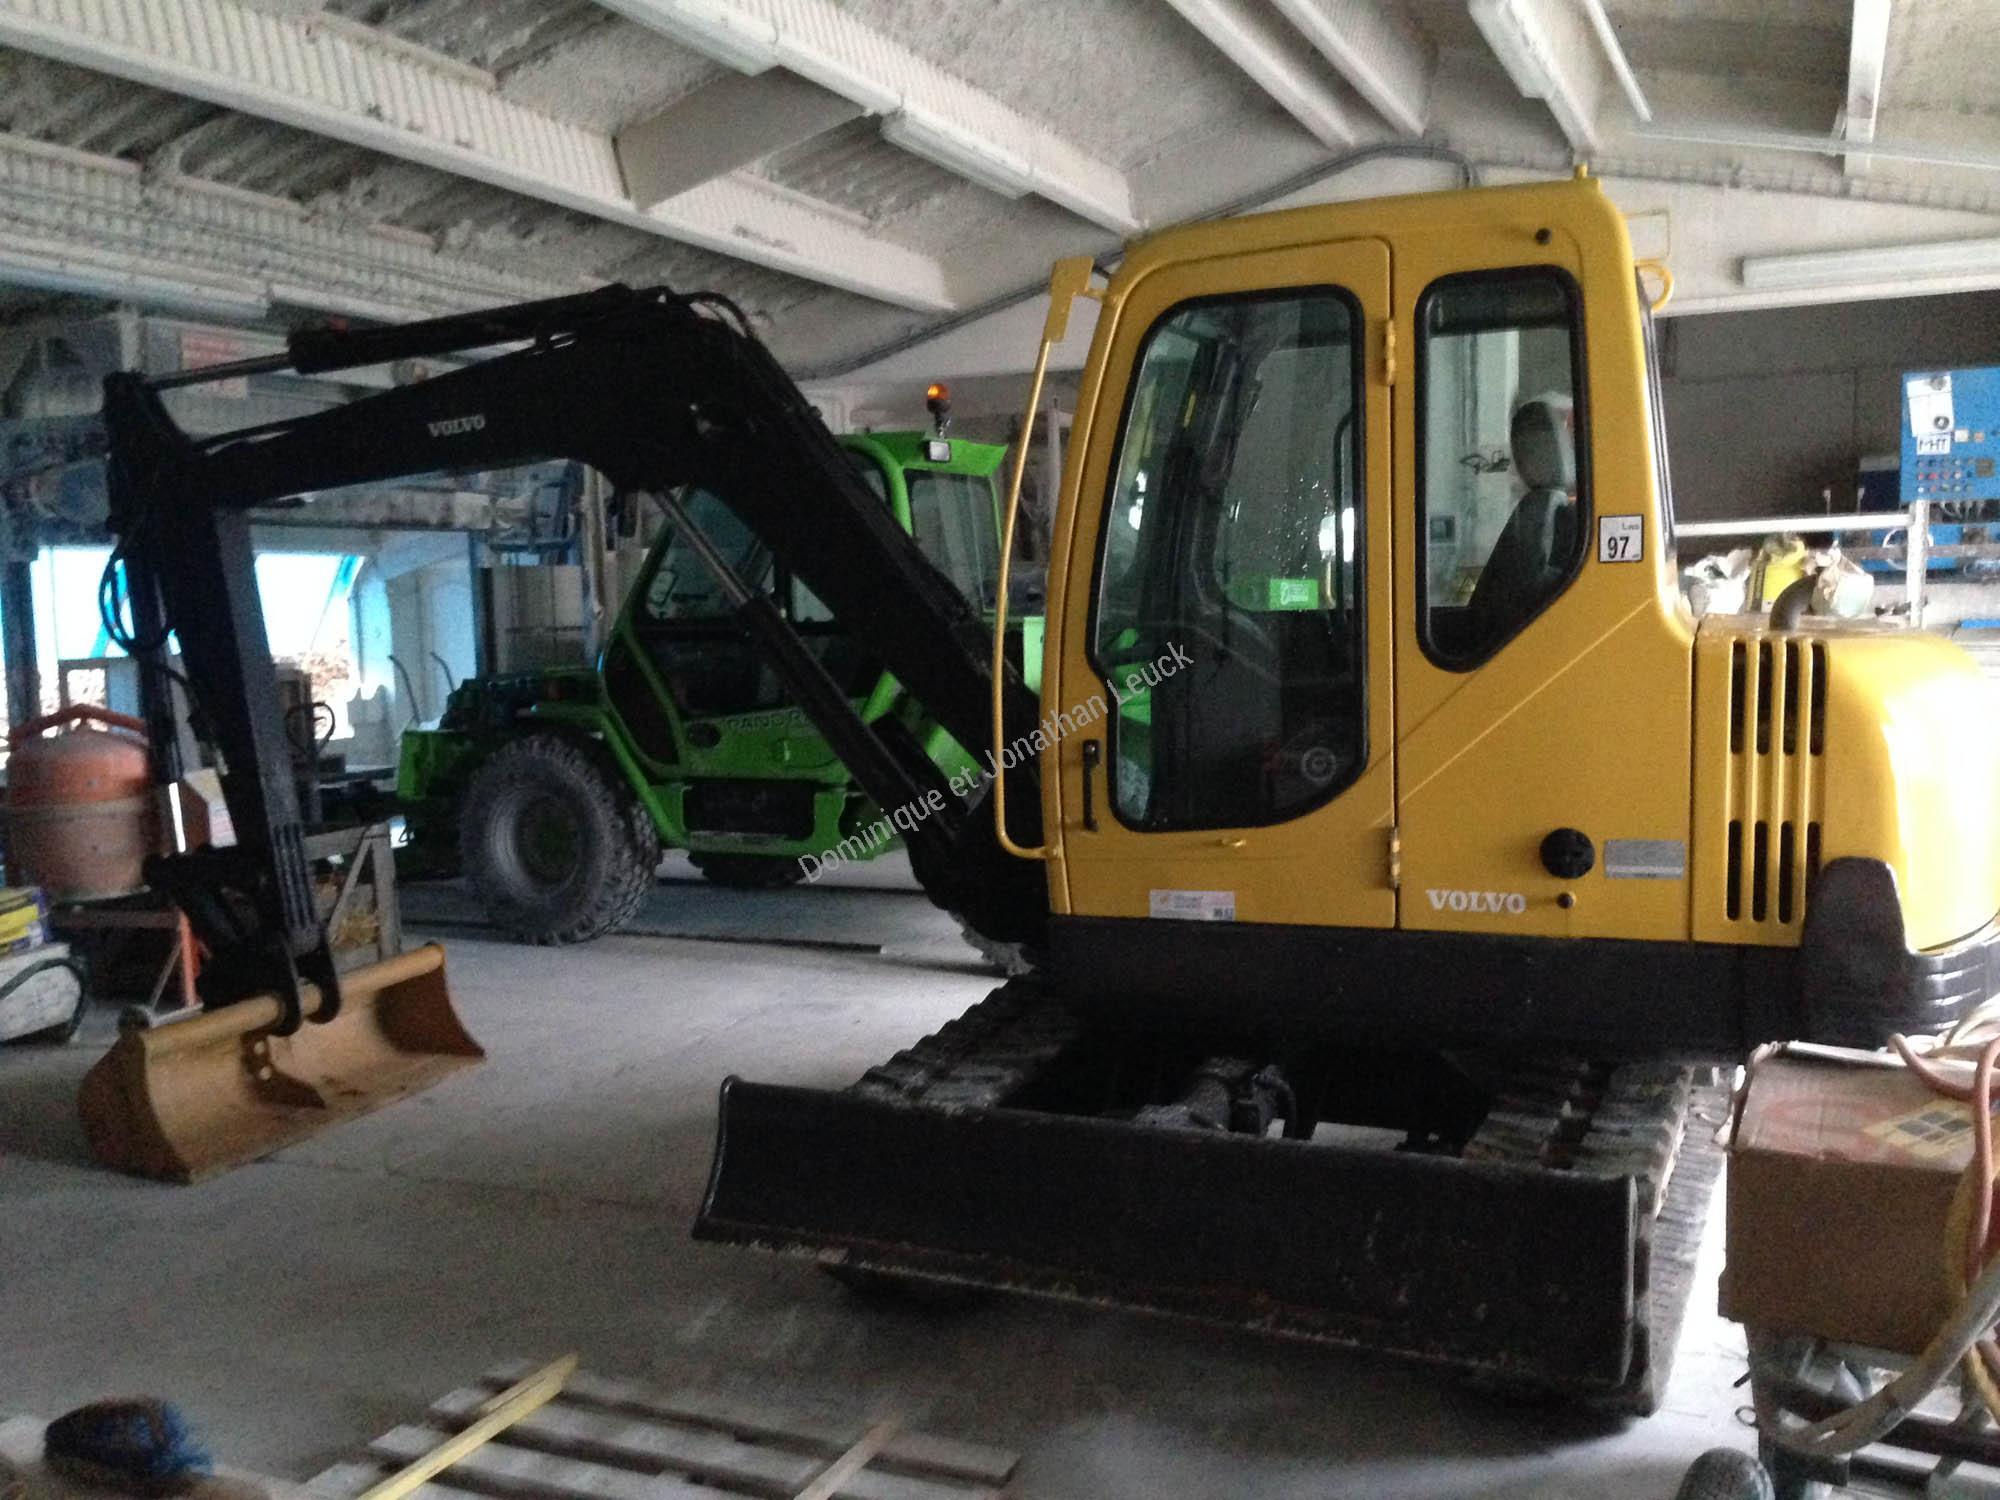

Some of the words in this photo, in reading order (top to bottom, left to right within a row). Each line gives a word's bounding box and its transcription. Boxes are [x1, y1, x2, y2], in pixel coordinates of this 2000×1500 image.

[427, 414, 485, 438] VOLVO
[1608, 536, 1629, 559] 97
[1425, 889, 1527, 914] VOLVO
